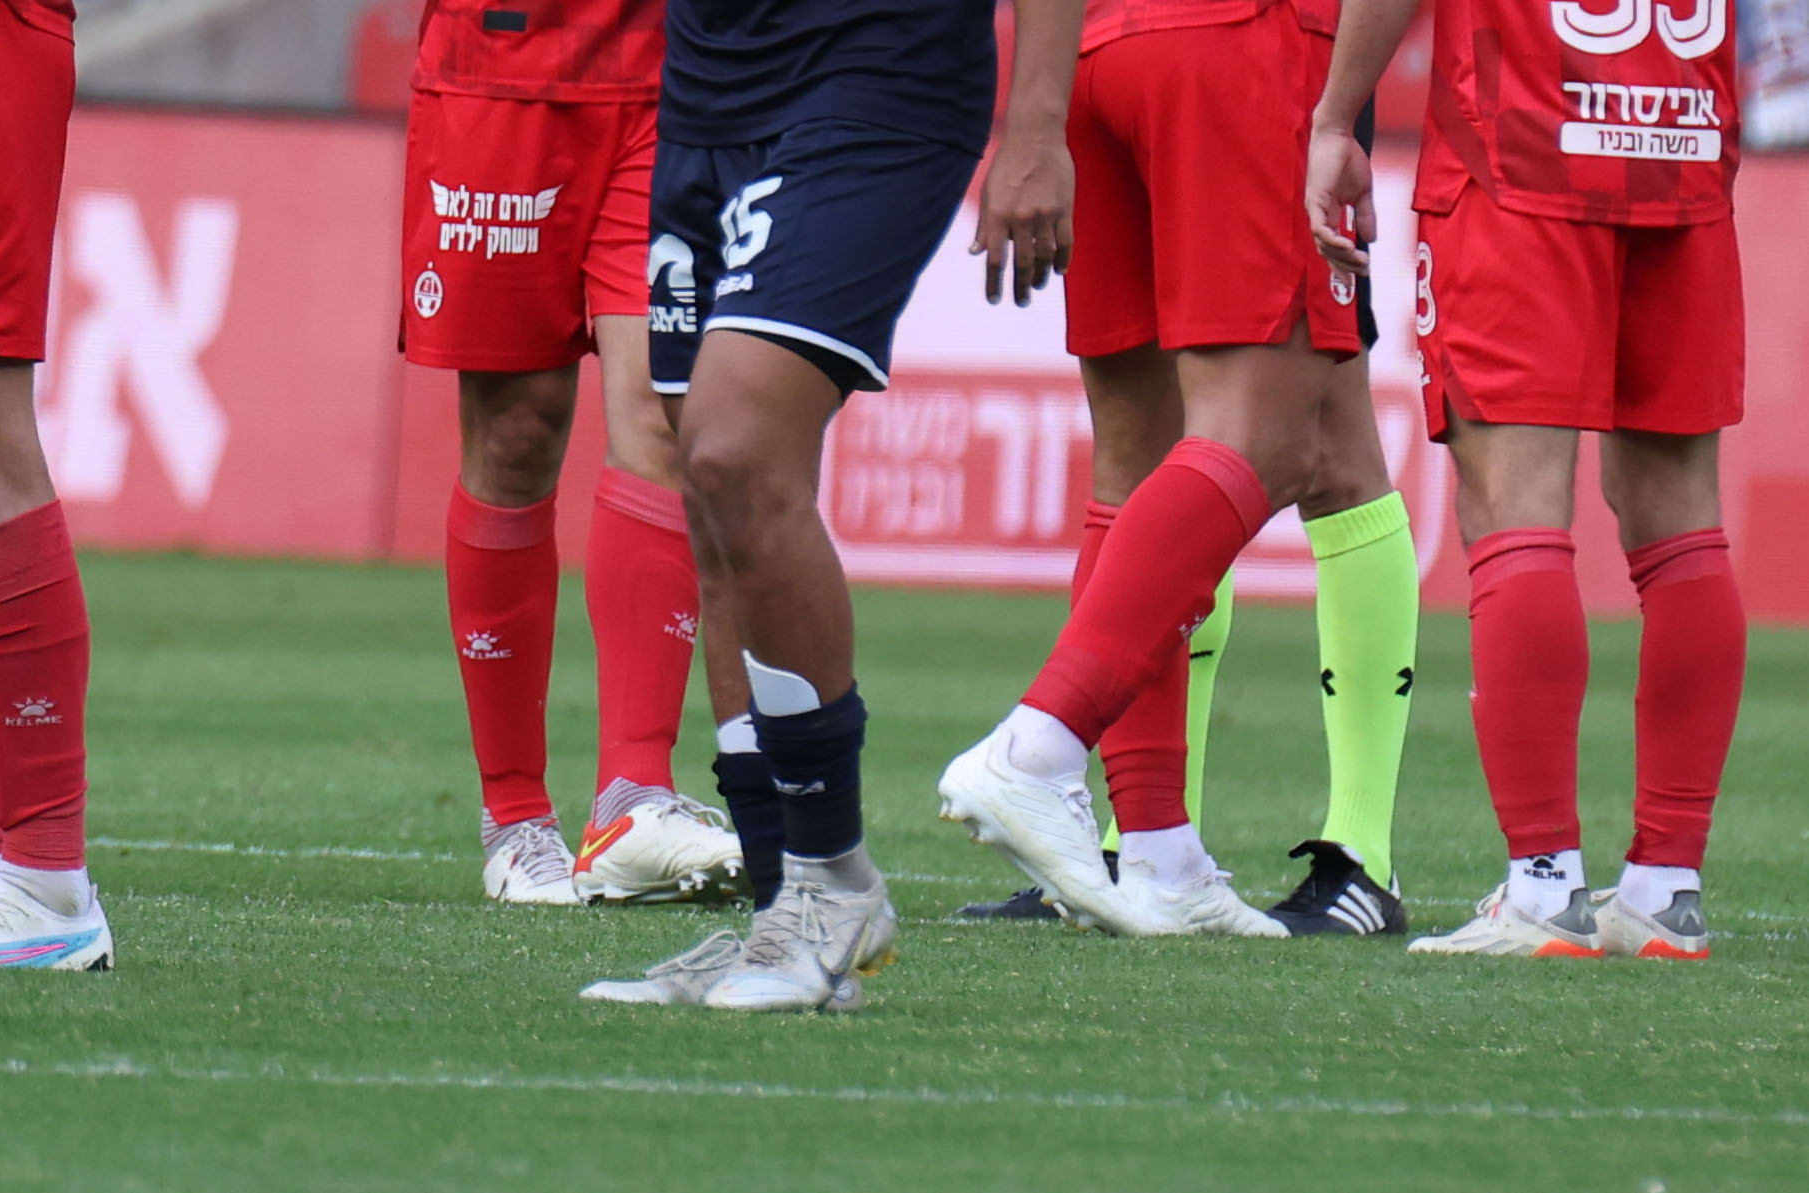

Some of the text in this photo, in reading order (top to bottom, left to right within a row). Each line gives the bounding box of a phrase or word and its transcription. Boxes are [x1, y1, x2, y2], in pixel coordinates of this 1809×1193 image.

[1562, 81, 1721, 127] אביסרור
[1597, 129, 1699, 156] משה ובניו
[448, 184, 471, 218] לא
[473, 192, 495, 220] זה
[438, 217, 540, 260] משחק ילדים
[4, 715, 63, 727] KELME
[1523, 868, 1567, 881] KELME
